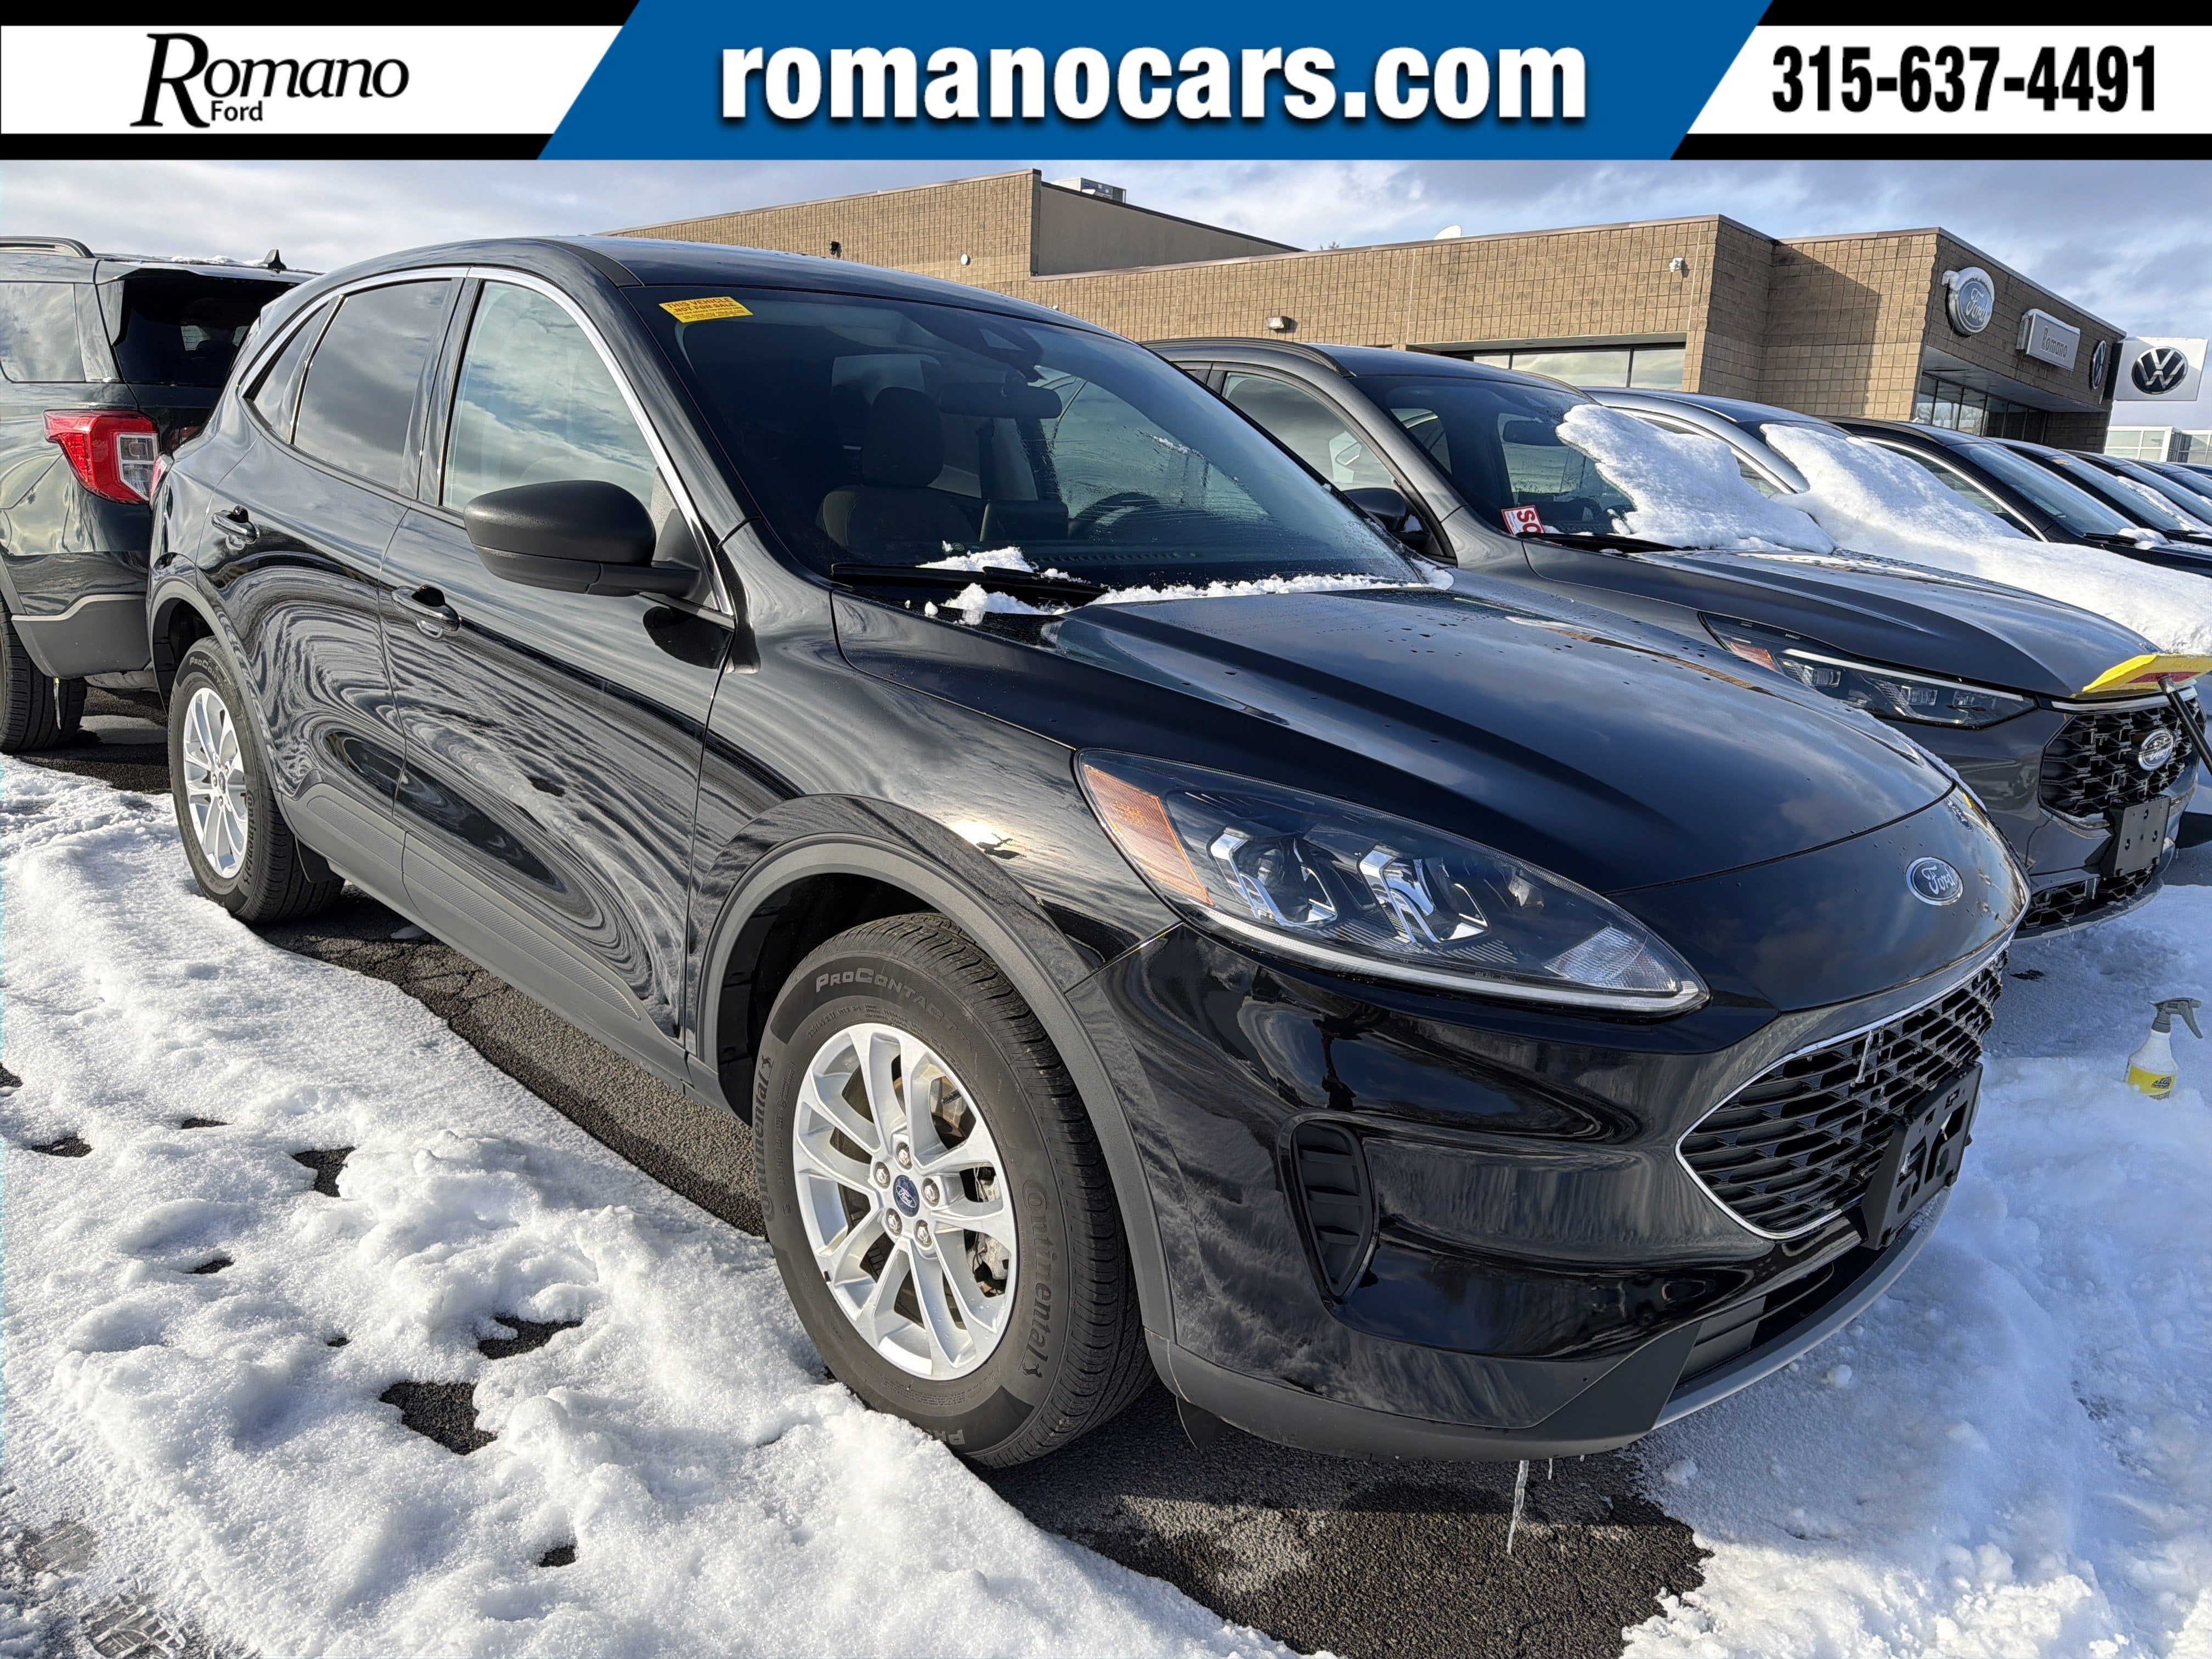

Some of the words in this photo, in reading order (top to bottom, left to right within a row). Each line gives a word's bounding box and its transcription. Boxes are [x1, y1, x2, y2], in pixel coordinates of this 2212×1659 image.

[690, 297, 733, 306] VEHICLE
[1966, 287, 1989, 322] Ford
[2041, 326, 2068, 360] Romano
[1921, 865, 1956, 895] Ford
[1022, 1180, 1058, 1363] Continental
